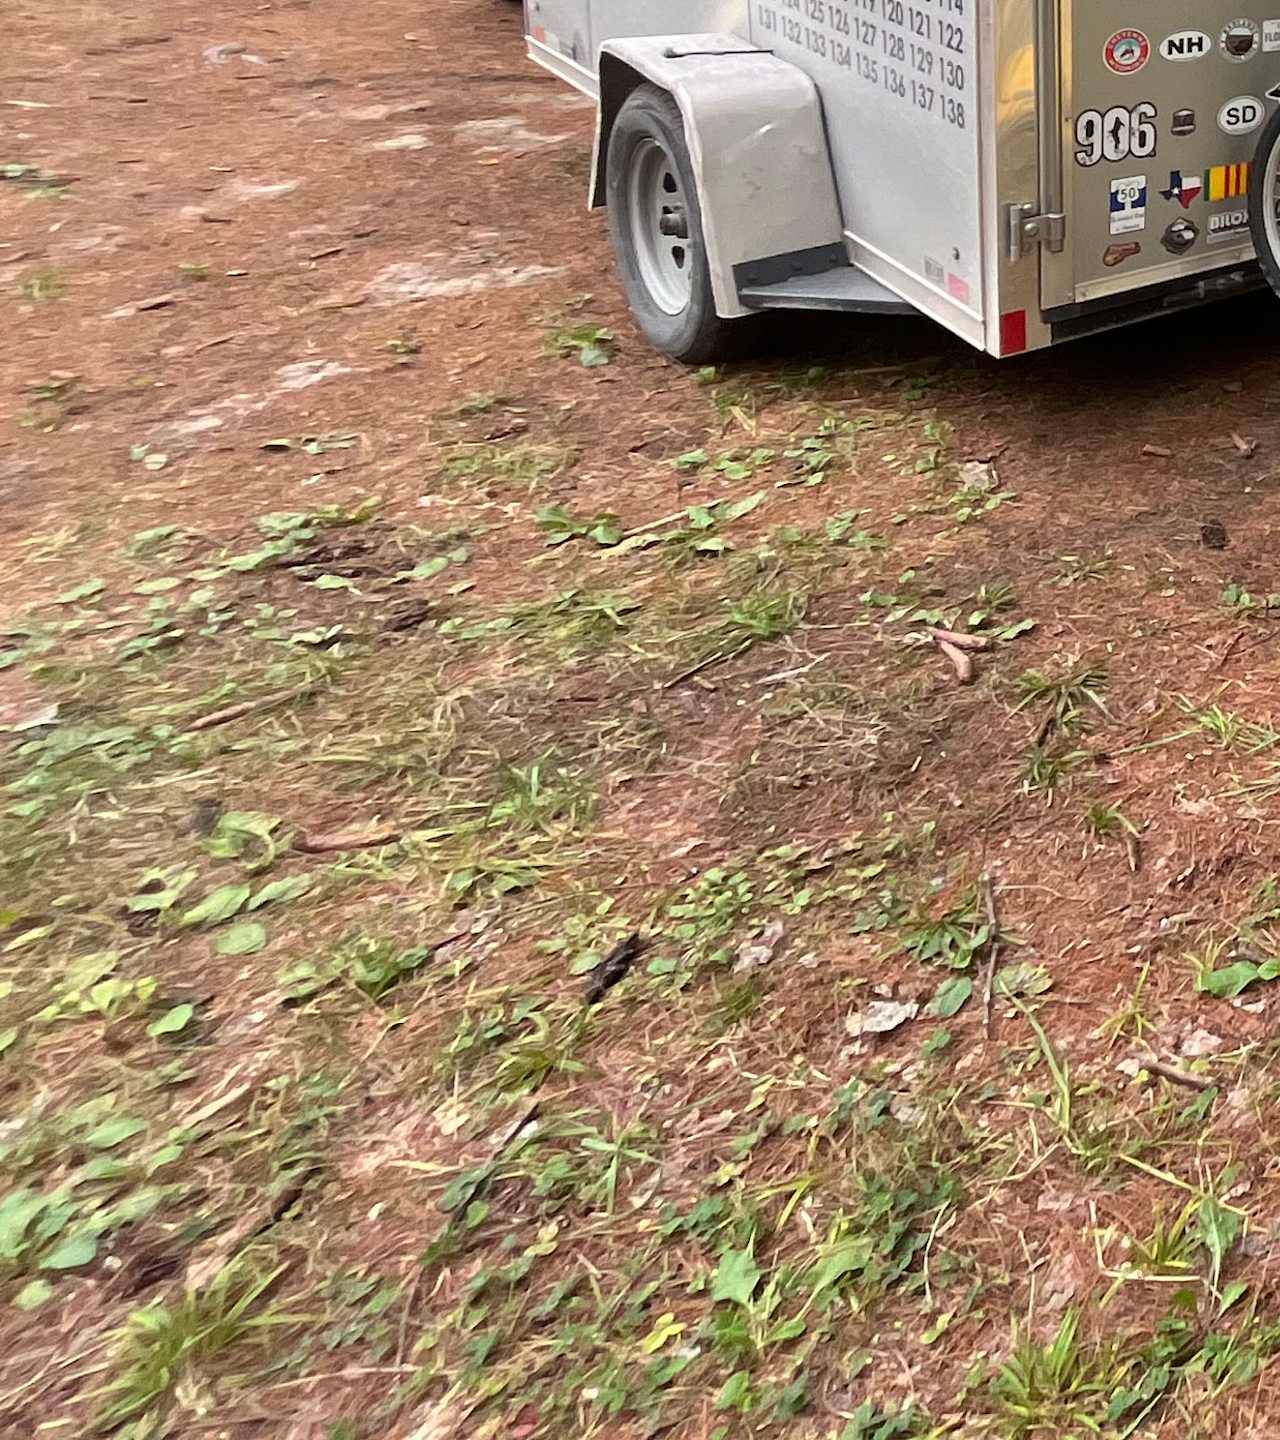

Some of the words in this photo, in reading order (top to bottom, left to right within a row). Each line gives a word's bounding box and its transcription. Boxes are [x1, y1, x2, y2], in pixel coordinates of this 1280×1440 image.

[828, 5, 850, 35] 126
[854, 17, 877, 47] 127
[882, 30, 905, 62] 128
[910, 43, 933, 76] 129
[939, 57, 964, 91] 130
[909, 7, 931, 40] 121
[938, 20, 964, 54] 122
[1168, 37, 1203, 55] NH
[758, 5, 777, 33] 131
[782, 15, 803, 45] 132
[805, 27, 826, 58] 133
[829, 39, 852, 70] 134
[855, 51, 879, 84] 135
[882, 65, 906, 98] 136
[911, 79, 934, 112] 137
[940, 94, 965, 129] 138
[1076, 103, 1157, 166] 906
[1226, 106, 1256, 126] SD
[1120, 187, 1137, 200] 50
